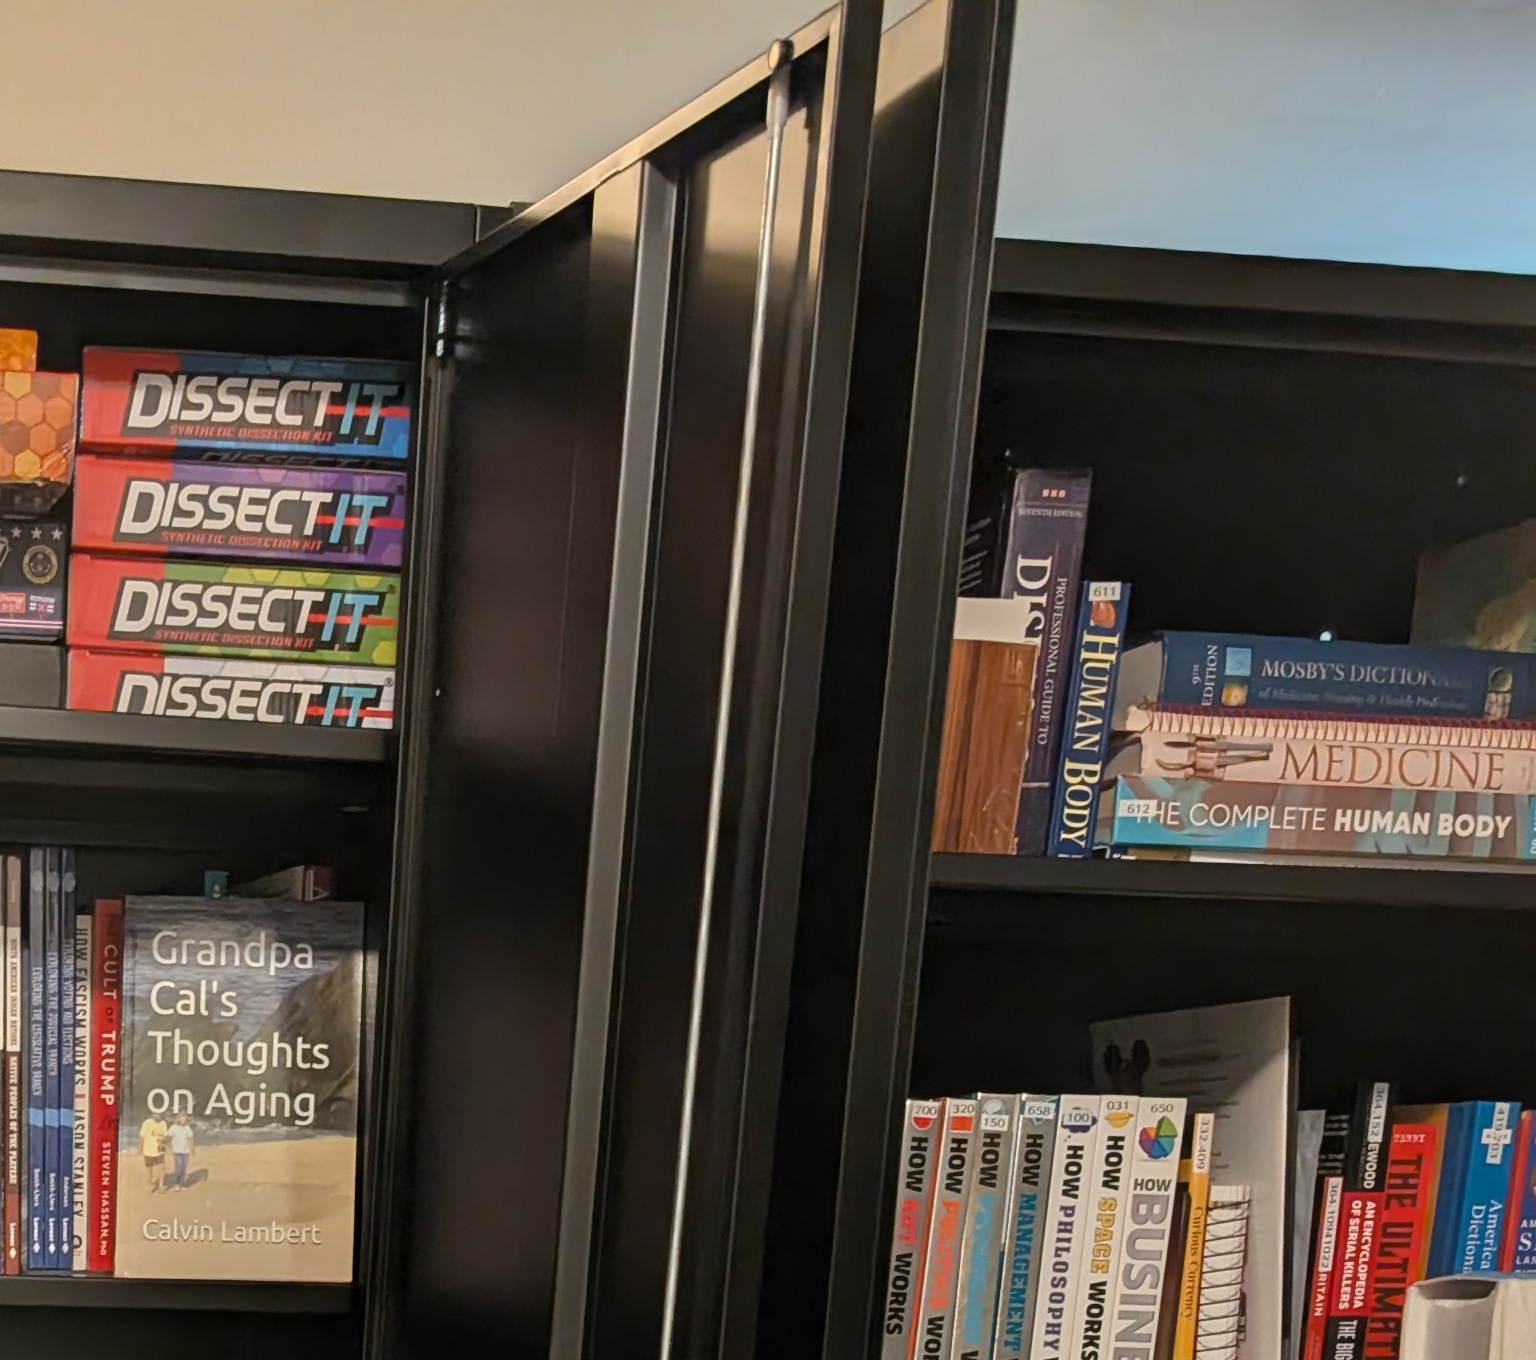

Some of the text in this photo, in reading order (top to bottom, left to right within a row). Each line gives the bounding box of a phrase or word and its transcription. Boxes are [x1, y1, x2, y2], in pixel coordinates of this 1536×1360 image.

[1094, 585, 1116, 597] 611
[1261, 659, 1345, 681] MOSBY'S
[1060, 628, 1120, 847] HUMAN BODY
[1279, 743, 1506, 791] MEDICINE
[1127, 803, 1151, 815] 612
[1189, 801, 1511, 839] COMPLETE HUMAN BODY
[152, 930, 314, 975] Grandpa
[150, 981, 238, 1017] Cal's
[147, 1030, 331, 1070] Thoughts
[147, 1083, 316, 1124] on Aging
[916, 1105, 937, 1115] 700
[1028, 1105, 1050, 1115] 658
[1150, 1103, 1173, 1114] 650
[1021, 1133, 1043, 1187] HOW
[1064, 1145, 1085, 1200] HOW
[1102, 1135, 1125, 1190] HOW
[1134, 1179, 1172, 1192] HOW
[142, 1219, 322, 1245] Calvin Lambert
[1090, 1197, 1118, 1275] SPACE
[1003, 1193, 1038, 1352] MANAGEMENT
[1042, 1204, 1075, 1352] PHILOSOPHY
